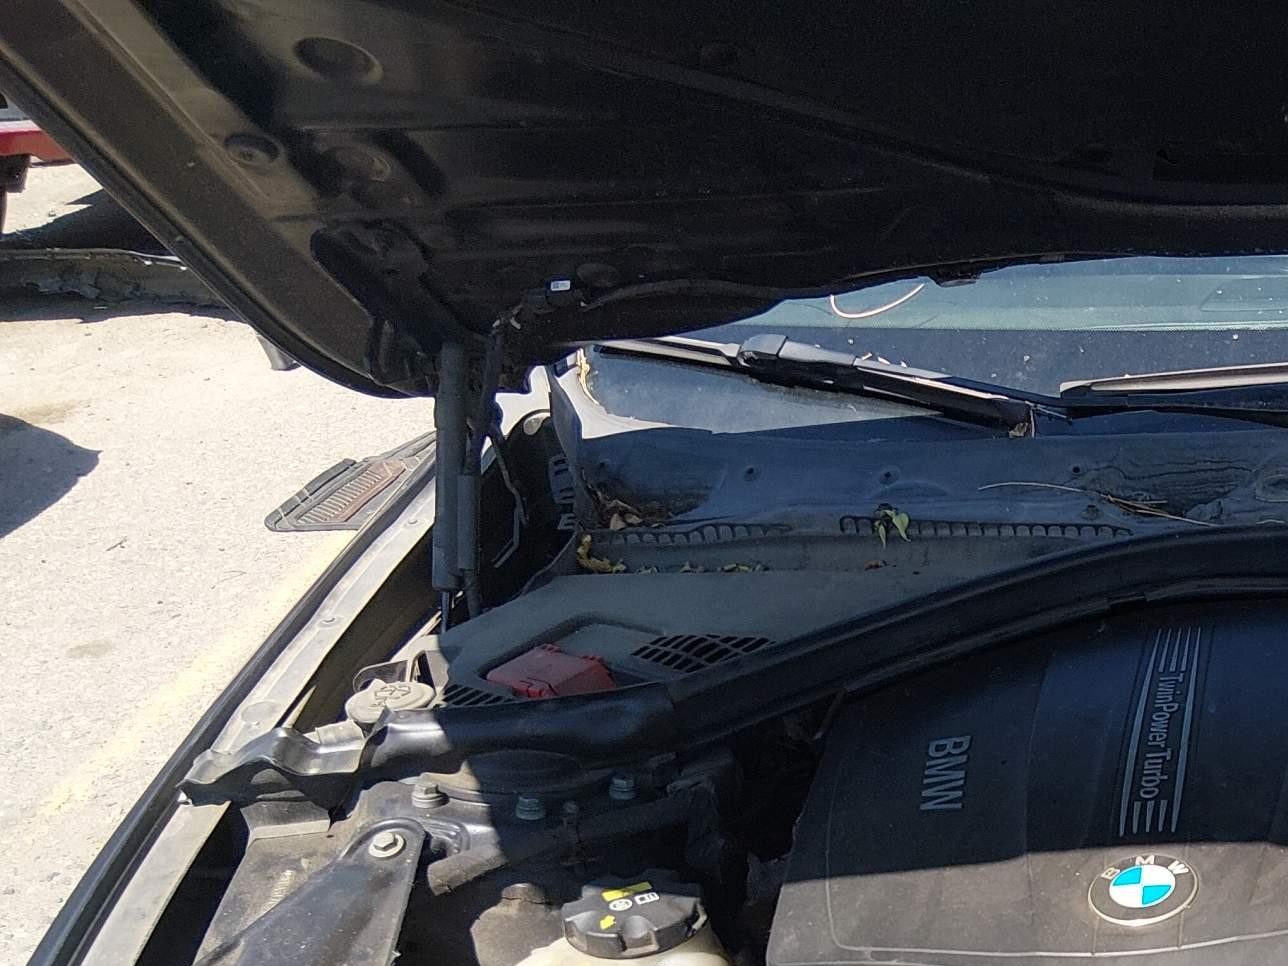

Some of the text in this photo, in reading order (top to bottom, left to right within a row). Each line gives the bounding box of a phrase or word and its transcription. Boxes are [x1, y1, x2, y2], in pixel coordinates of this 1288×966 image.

[920, 735, 971, 810] BMW
[1140, 672, 1185, 799] TwinPower Turbo
[1101, 855, 1189, 880] BMW
